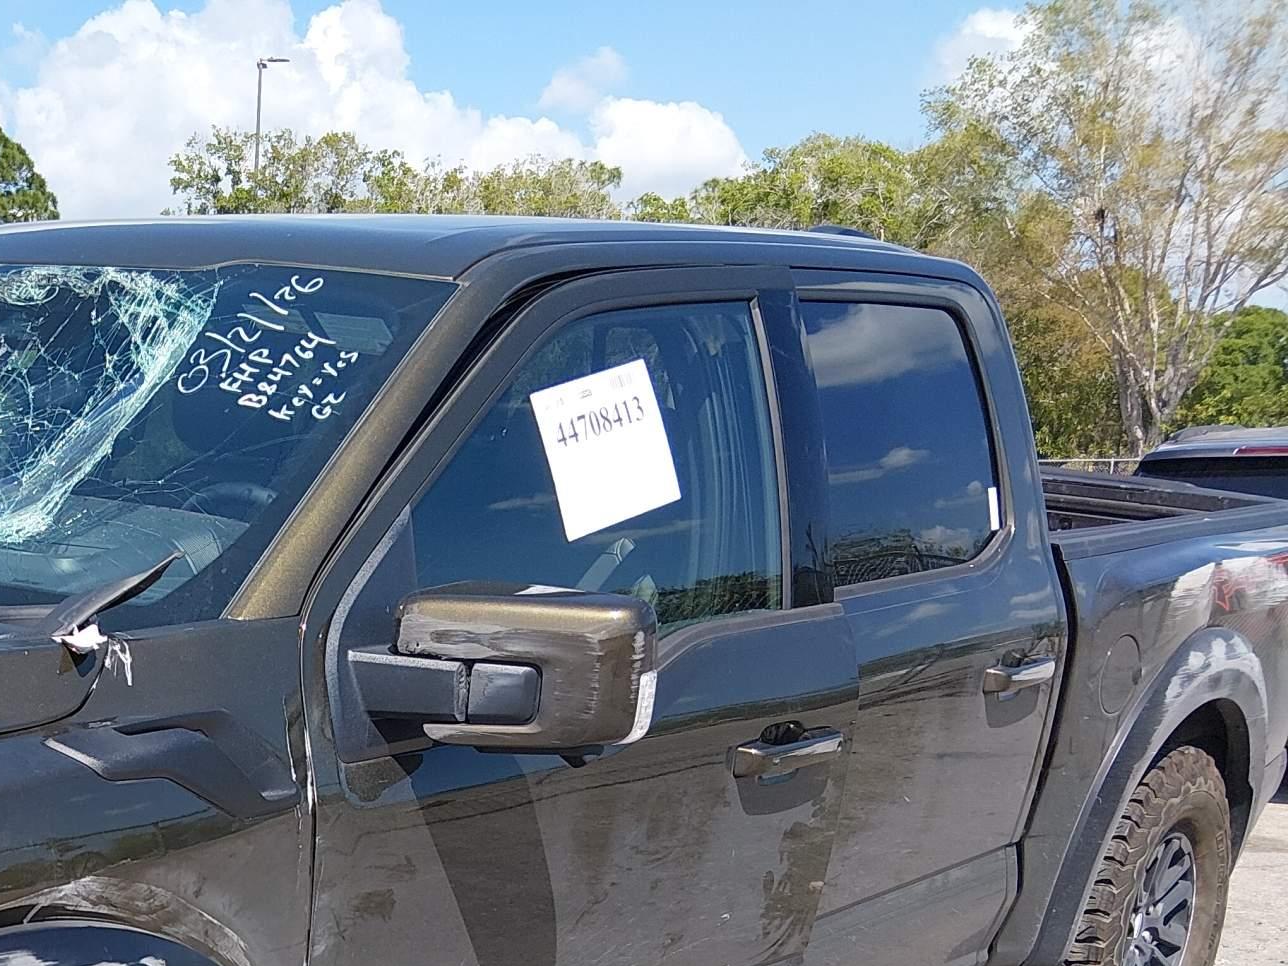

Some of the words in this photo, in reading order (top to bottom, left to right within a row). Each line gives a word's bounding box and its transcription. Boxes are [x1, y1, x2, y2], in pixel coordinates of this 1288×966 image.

[219, 348, 273, 393] FHP
[237, 331, 337, 408] B84764
[556, 395, 645, 447] 44708413
